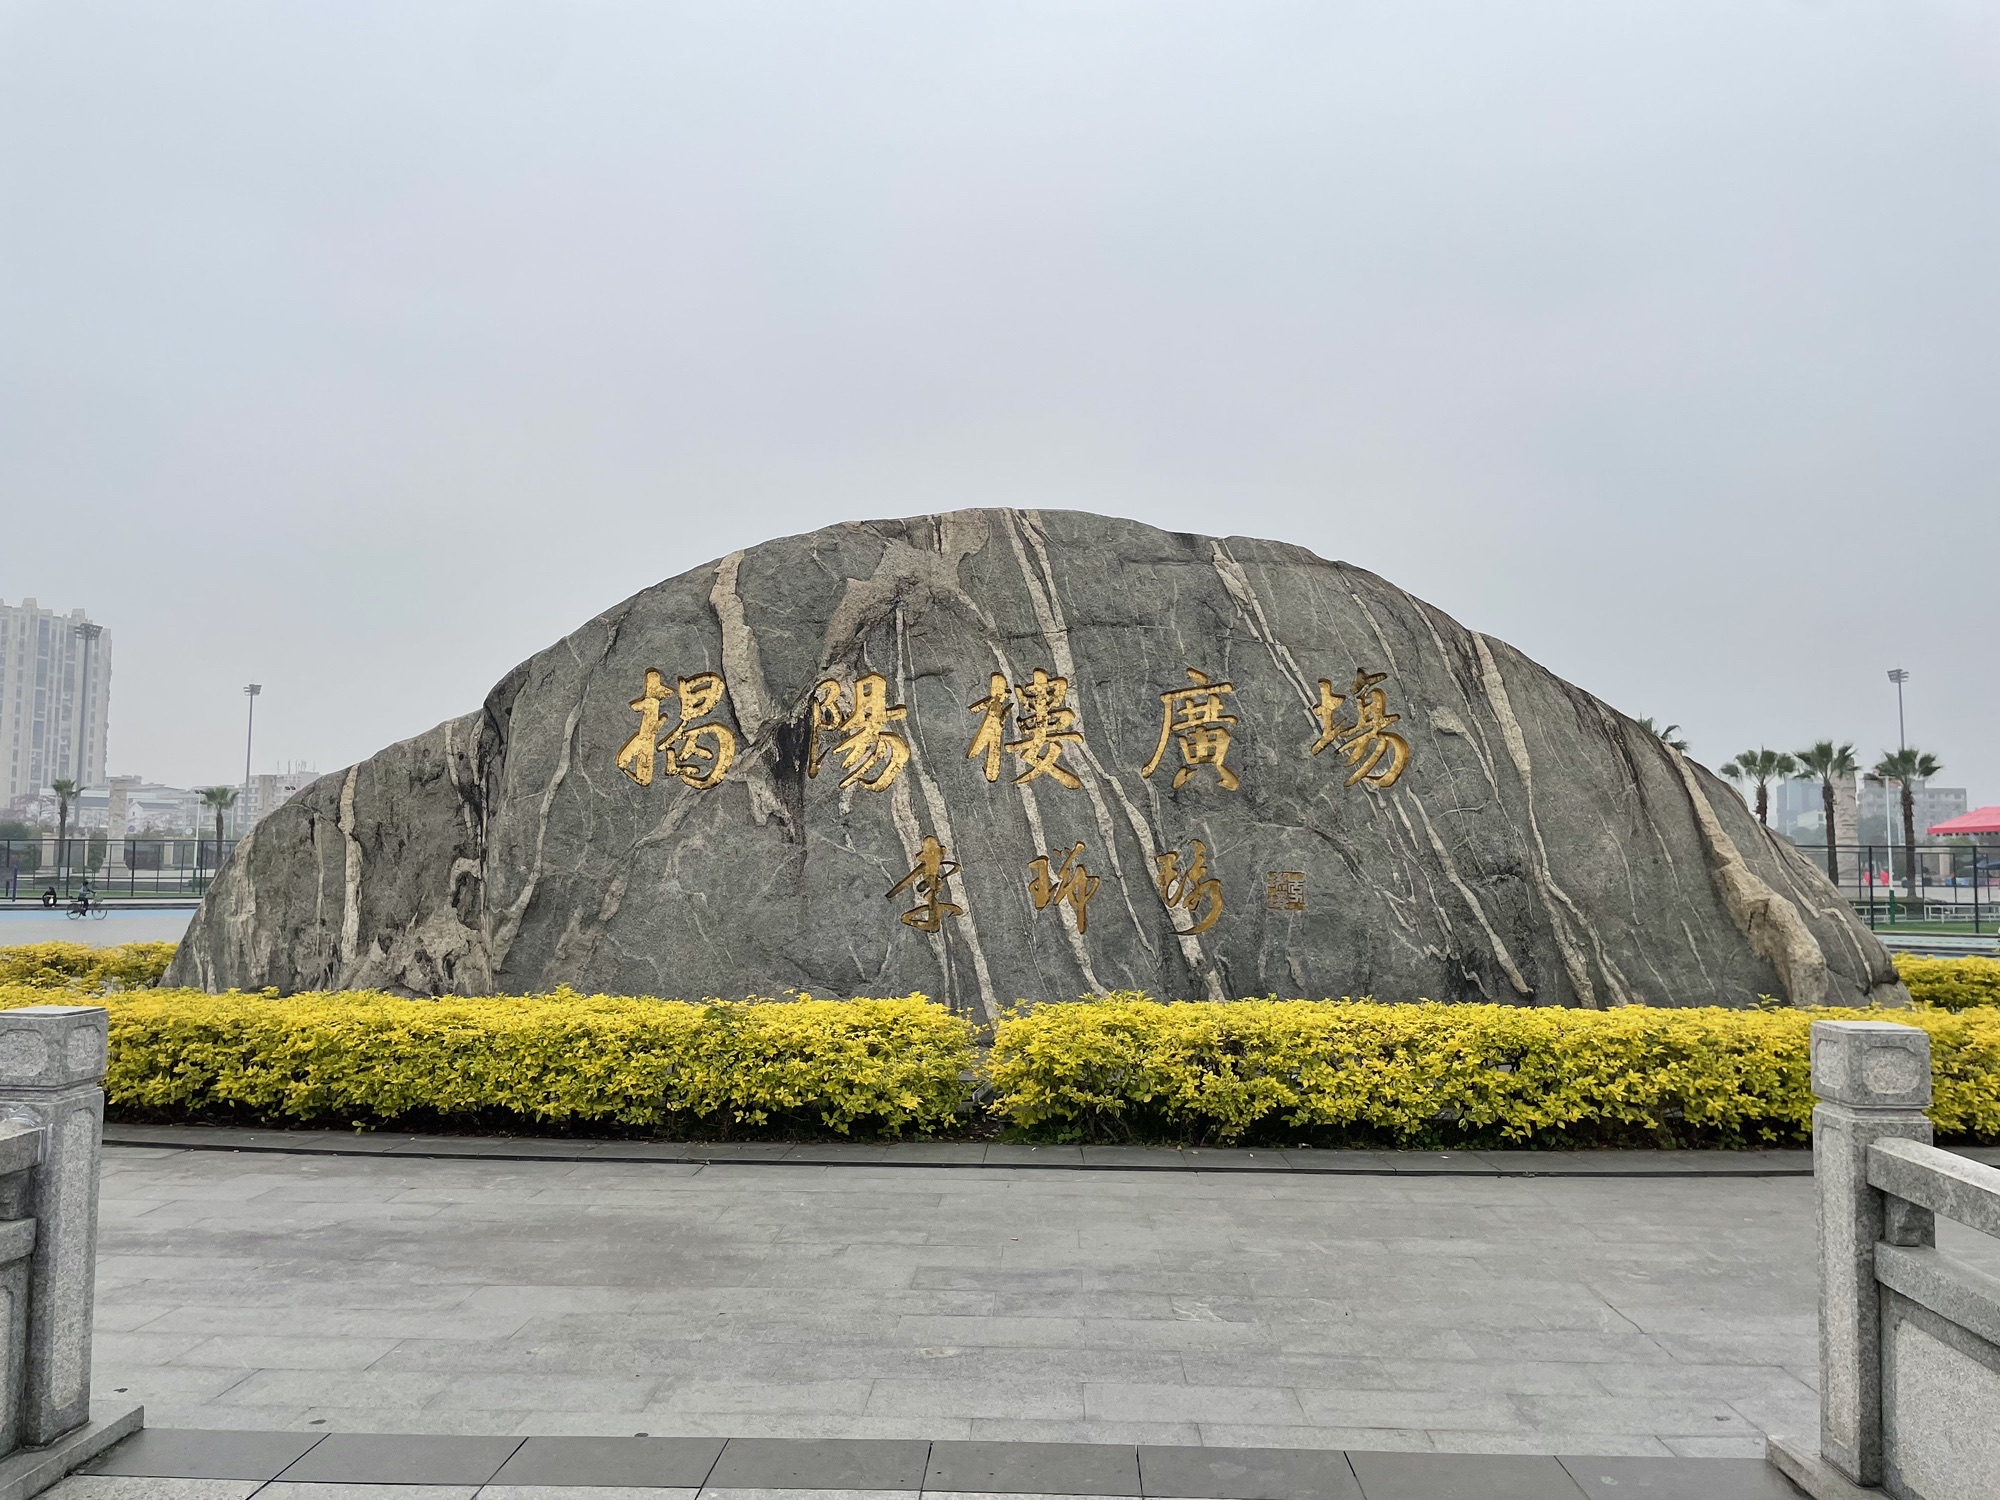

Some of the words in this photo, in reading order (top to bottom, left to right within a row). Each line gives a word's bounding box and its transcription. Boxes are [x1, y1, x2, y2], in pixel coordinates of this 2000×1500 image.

[616, 667, 1410, 792] 揭陽樓廣場
